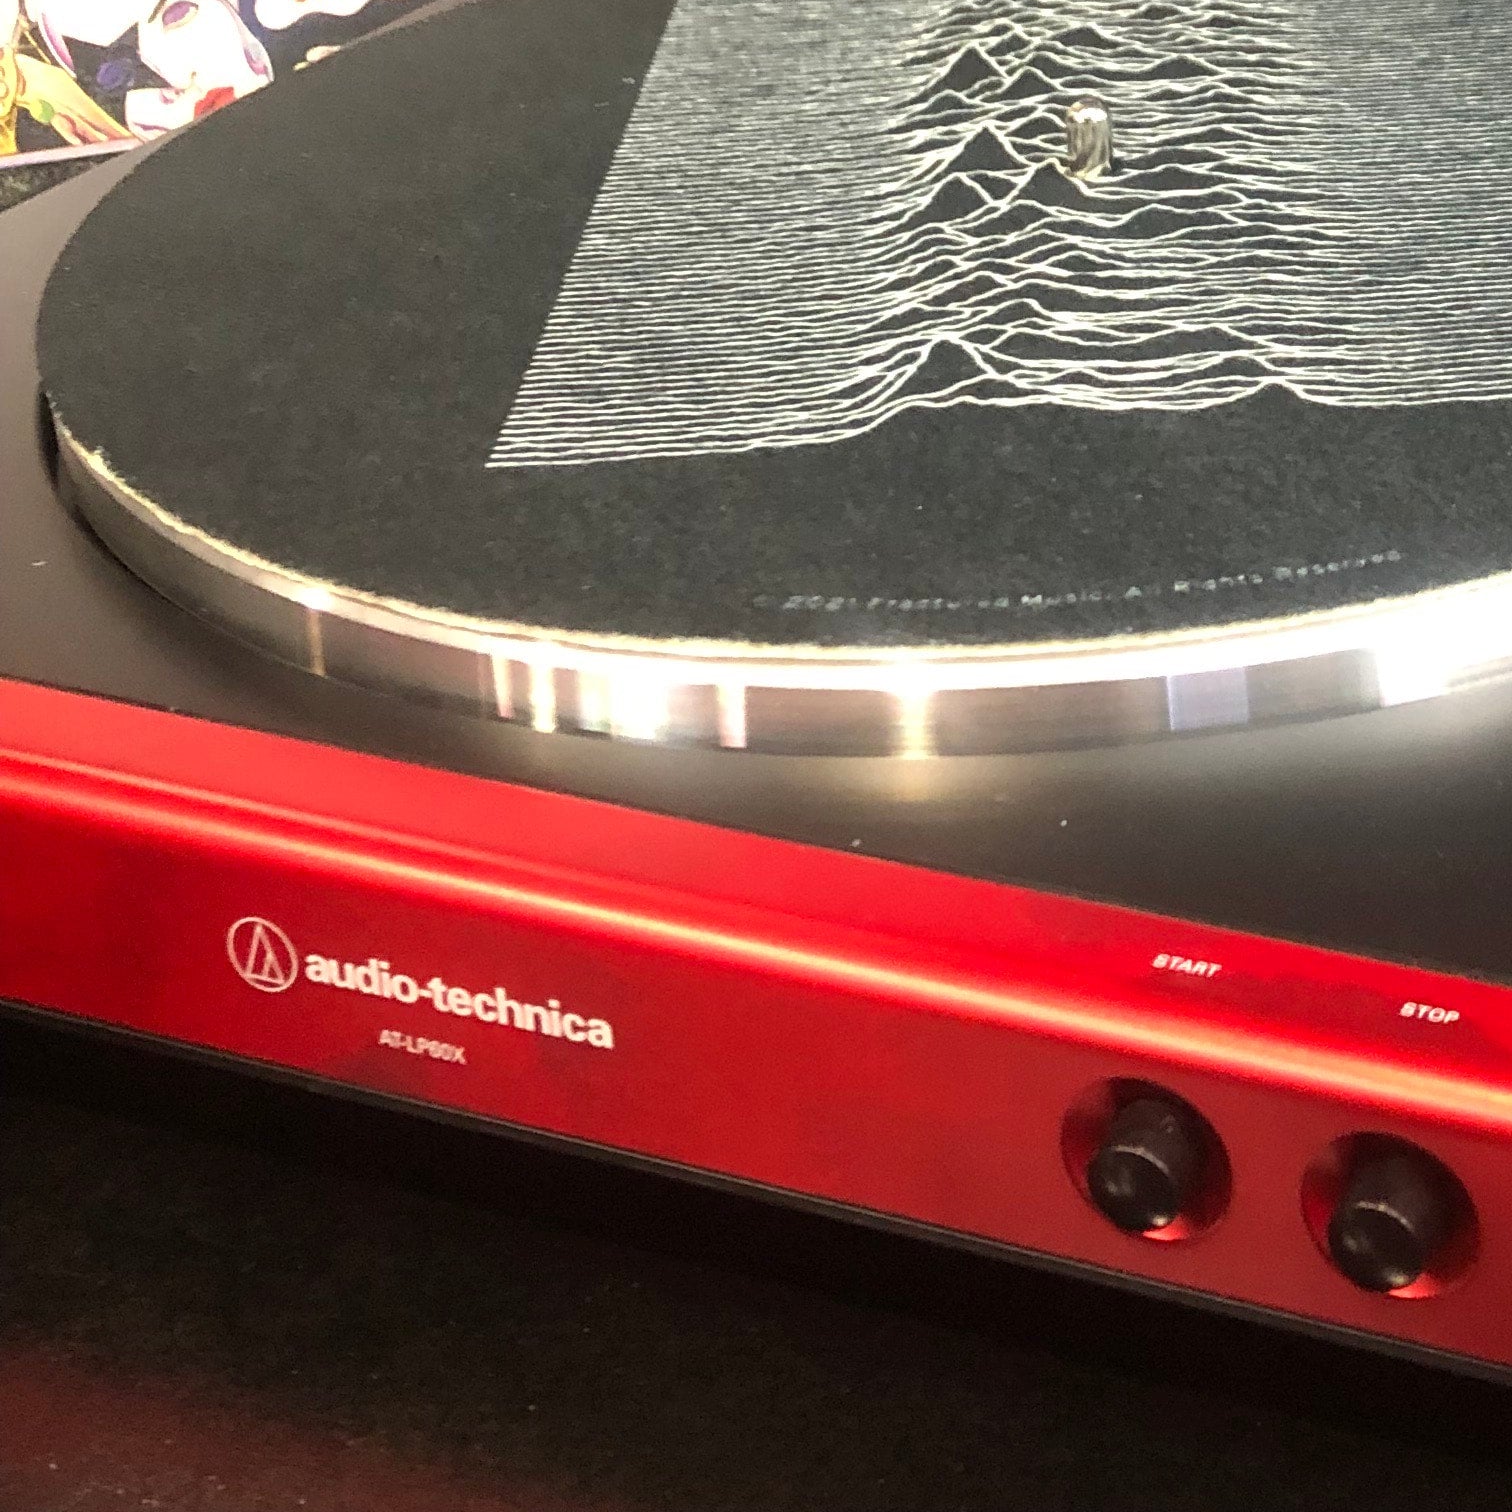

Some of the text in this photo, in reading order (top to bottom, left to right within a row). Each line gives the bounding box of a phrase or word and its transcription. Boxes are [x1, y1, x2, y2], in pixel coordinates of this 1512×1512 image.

[1151, 953, 1223, 979] START
[305, 953, 616, 1050] audio-technica
[1399, 1001, 1461, 1025] STOP
